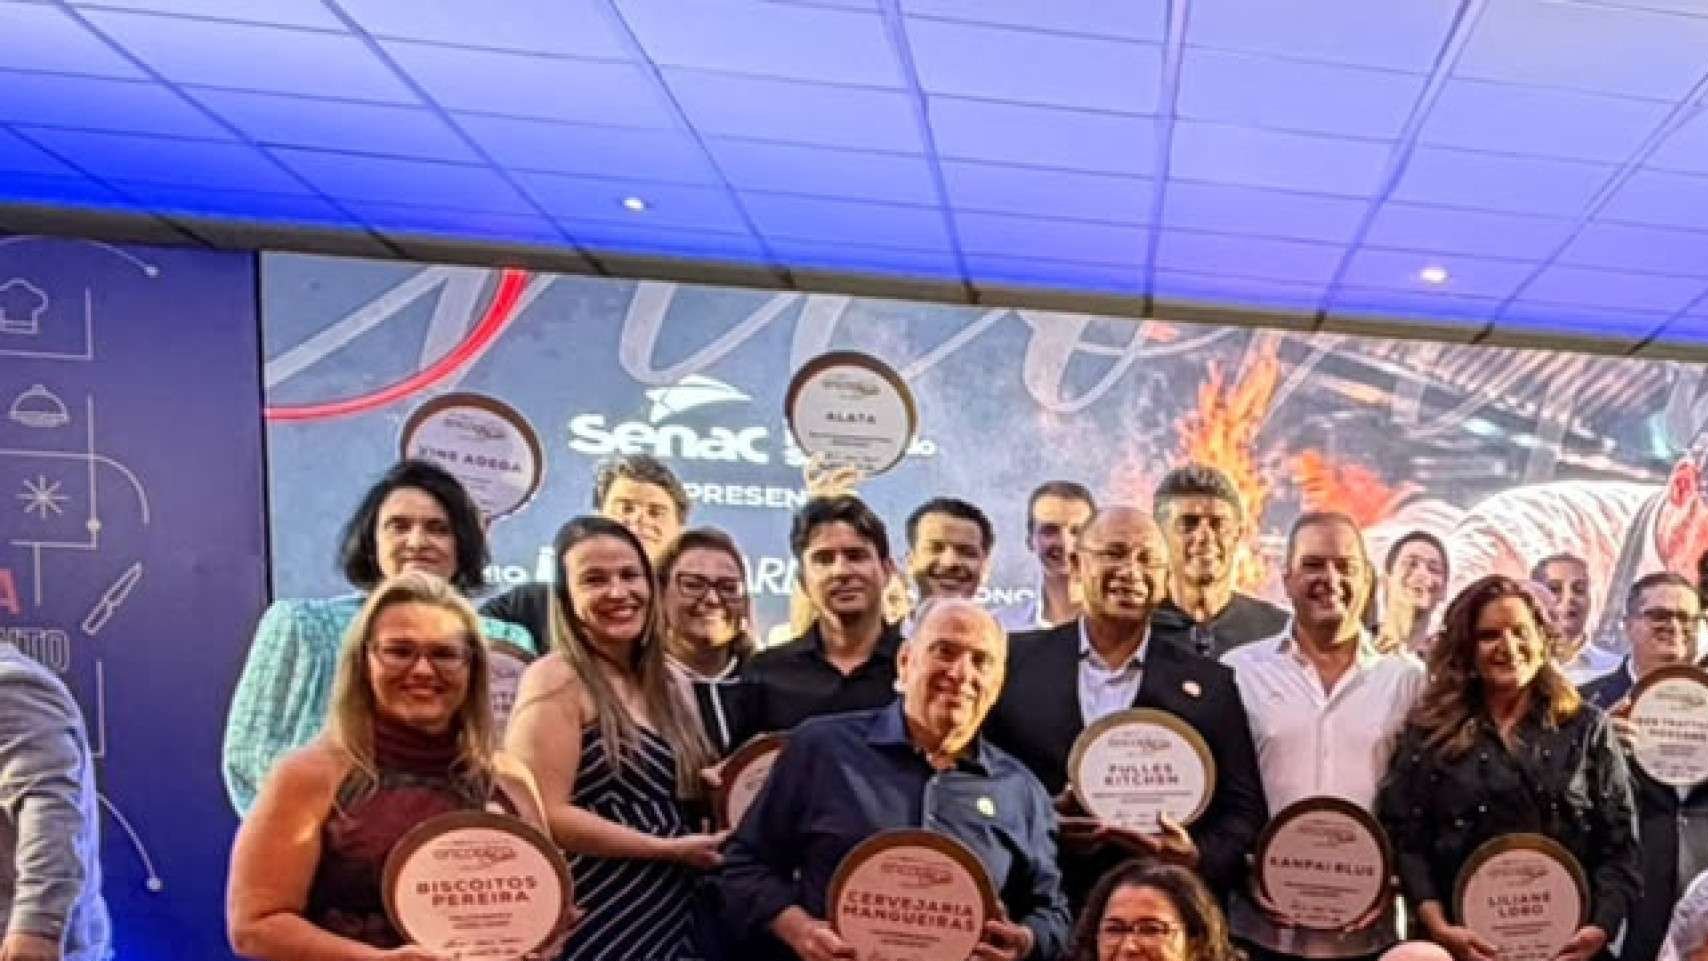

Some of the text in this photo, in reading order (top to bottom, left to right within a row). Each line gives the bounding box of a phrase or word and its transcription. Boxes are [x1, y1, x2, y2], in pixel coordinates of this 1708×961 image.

[568, 413, 769, 465] Senac
[415, 875, 538, 895] BISCOITOS
[431, 890, 531, 906] PEREIRA
[848, 889, 973, 916] CERVEJARIA
[843, 904, 975, 932] MANGUEIRAS
[1498, 905, 1544, 918] LOBO
